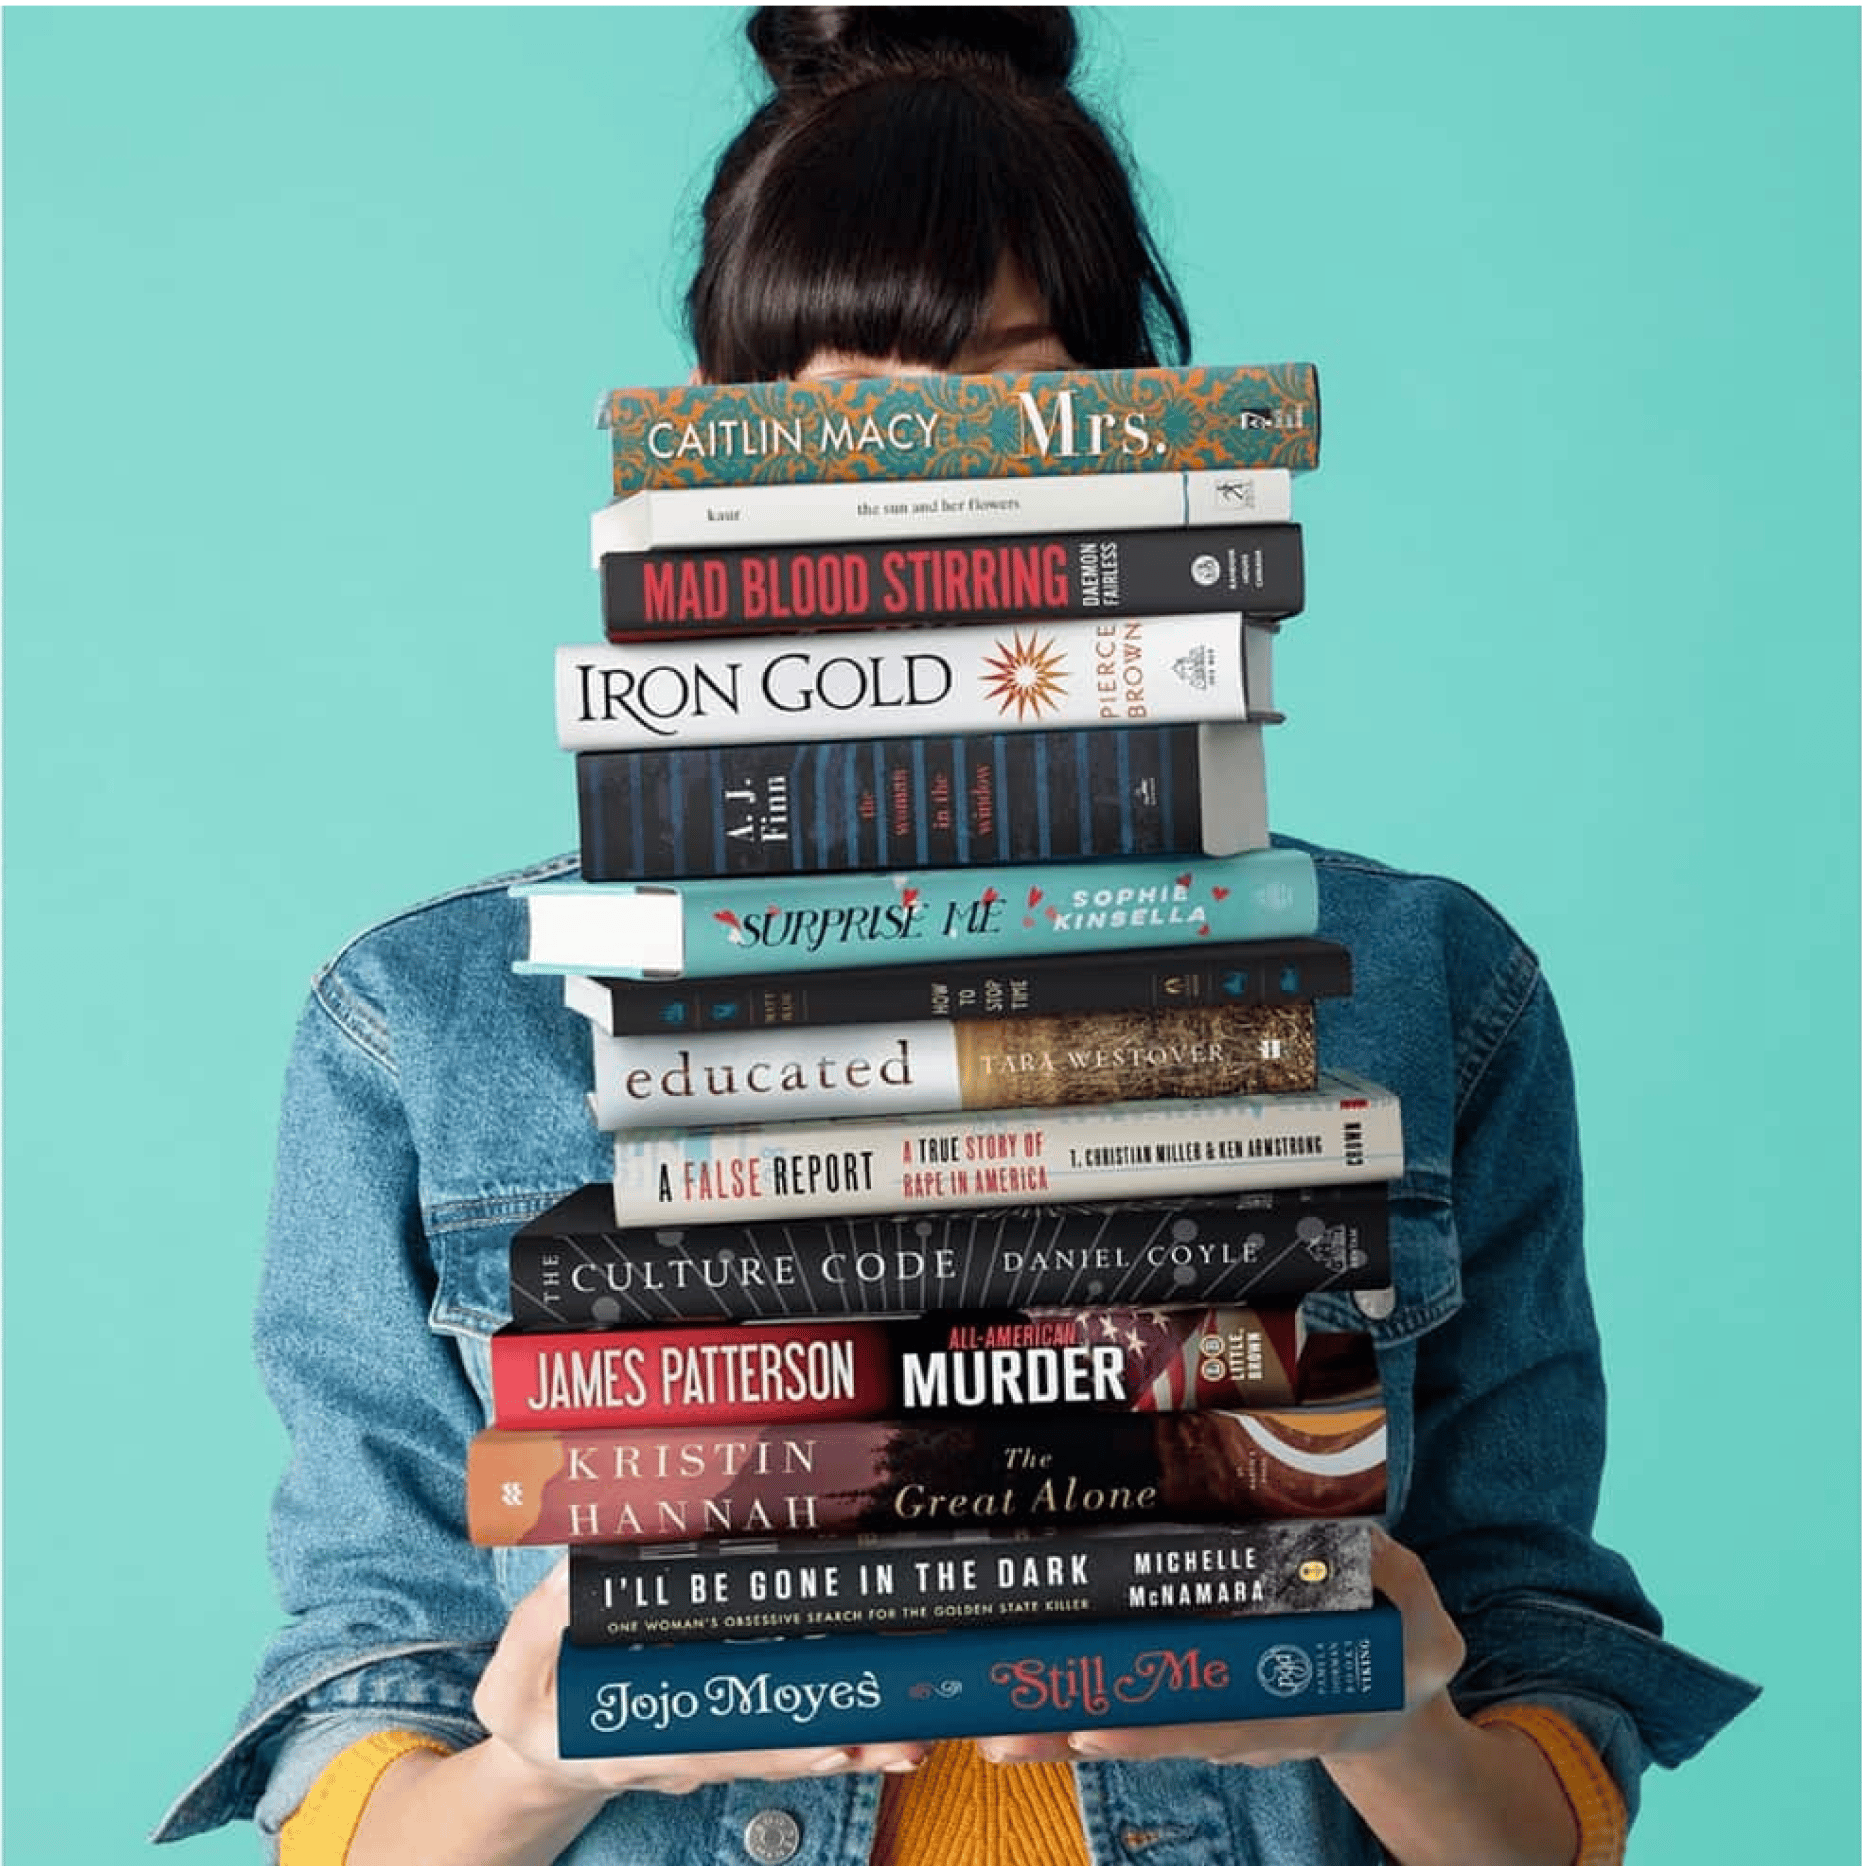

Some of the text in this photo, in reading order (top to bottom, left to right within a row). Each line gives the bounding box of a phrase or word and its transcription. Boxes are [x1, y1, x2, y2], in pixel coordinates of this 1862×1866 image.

[648, 412, 940, 460] CAITLIN MACY
[1014, 389, 1169, 460] Mrs.
[707, 506, 741, 522] kaur
[857, 495, 1021, 517] the sun and her flowers
[642, 543, 1069, 623] MAD BLOOD STIRRING
[1079, 542, 1100, 607] DAEMON
[1100, 541, 1120, 607] FAIRLESS
[1095, 624, 1119, 718] PIERCE
[1123, 620, 1147, 718] BROWN
[575, 653, 954, 735] IRON GOLD
[724, 777, 757, 842] A. J.
[760, 775, 789, 842] Finn
[1071, 883, 1190, 907] SOPHIE
[738, 899, 1009, 952] SURPRISE ME
[1053, 905, 1206, 932] KINSELLA
[931, 982, 949, 1014] HOW
[958, 989, 975, 1006] TO
[983, 979, 1004, 1011] STOP
[1010, 979, 1030, 1010] TIME
[624, 1040, 915, 1100] educated
[978, 1041, 1226, 1077] TARA WESTOVER
[903, 1130, 1043, 1164] A TRUE STORY OF
[1069, 1135, 1323, 1168] T. CHRISTIAN MILLER & KEN ARMSTRONG
[658, 1150, 874, 1203] A FALSE REPORT
[903, 1165, 1048, 1198] RAPE IN AMERICA
[541, 1252, 560, 1305] THE
[571, 1248, 958, 1293] CULTURE CODE
[1003, 1241, 1260, 1273] DANIEL COYLE
[948, 1322, 1077, 1351] ALL-AMERICAN
[527, 1339, 856, 1411] JAMES PATTERSON
[902, 1345, 1128, 1409] MURDER
[567, 1438, 817, 1482] KRISTIN
[1003, 1447, 1054, 1470] The
[569, 1496, 819, 1537] HANNAH
[895, 1475, 1158, 1519] Great Alone
[604, 1554, 1089, 1608] I'LL BE GONE IN THE DARK
[1134, 1546, 1258, 1576] MICHELLE
[1129, 1578, 1265, 1609] McNAMARA
[607, 1598, 1089, 1635] ONE WOMAN'S OBSESSIVE SEARCH FOR THE GOLDEN STATE KILLER
[590, 1670, 882, 1732] Jojo Moyes
[989, 1654, 1111, 1716] Still
[1113, 1647, 1231, 1703] Me
